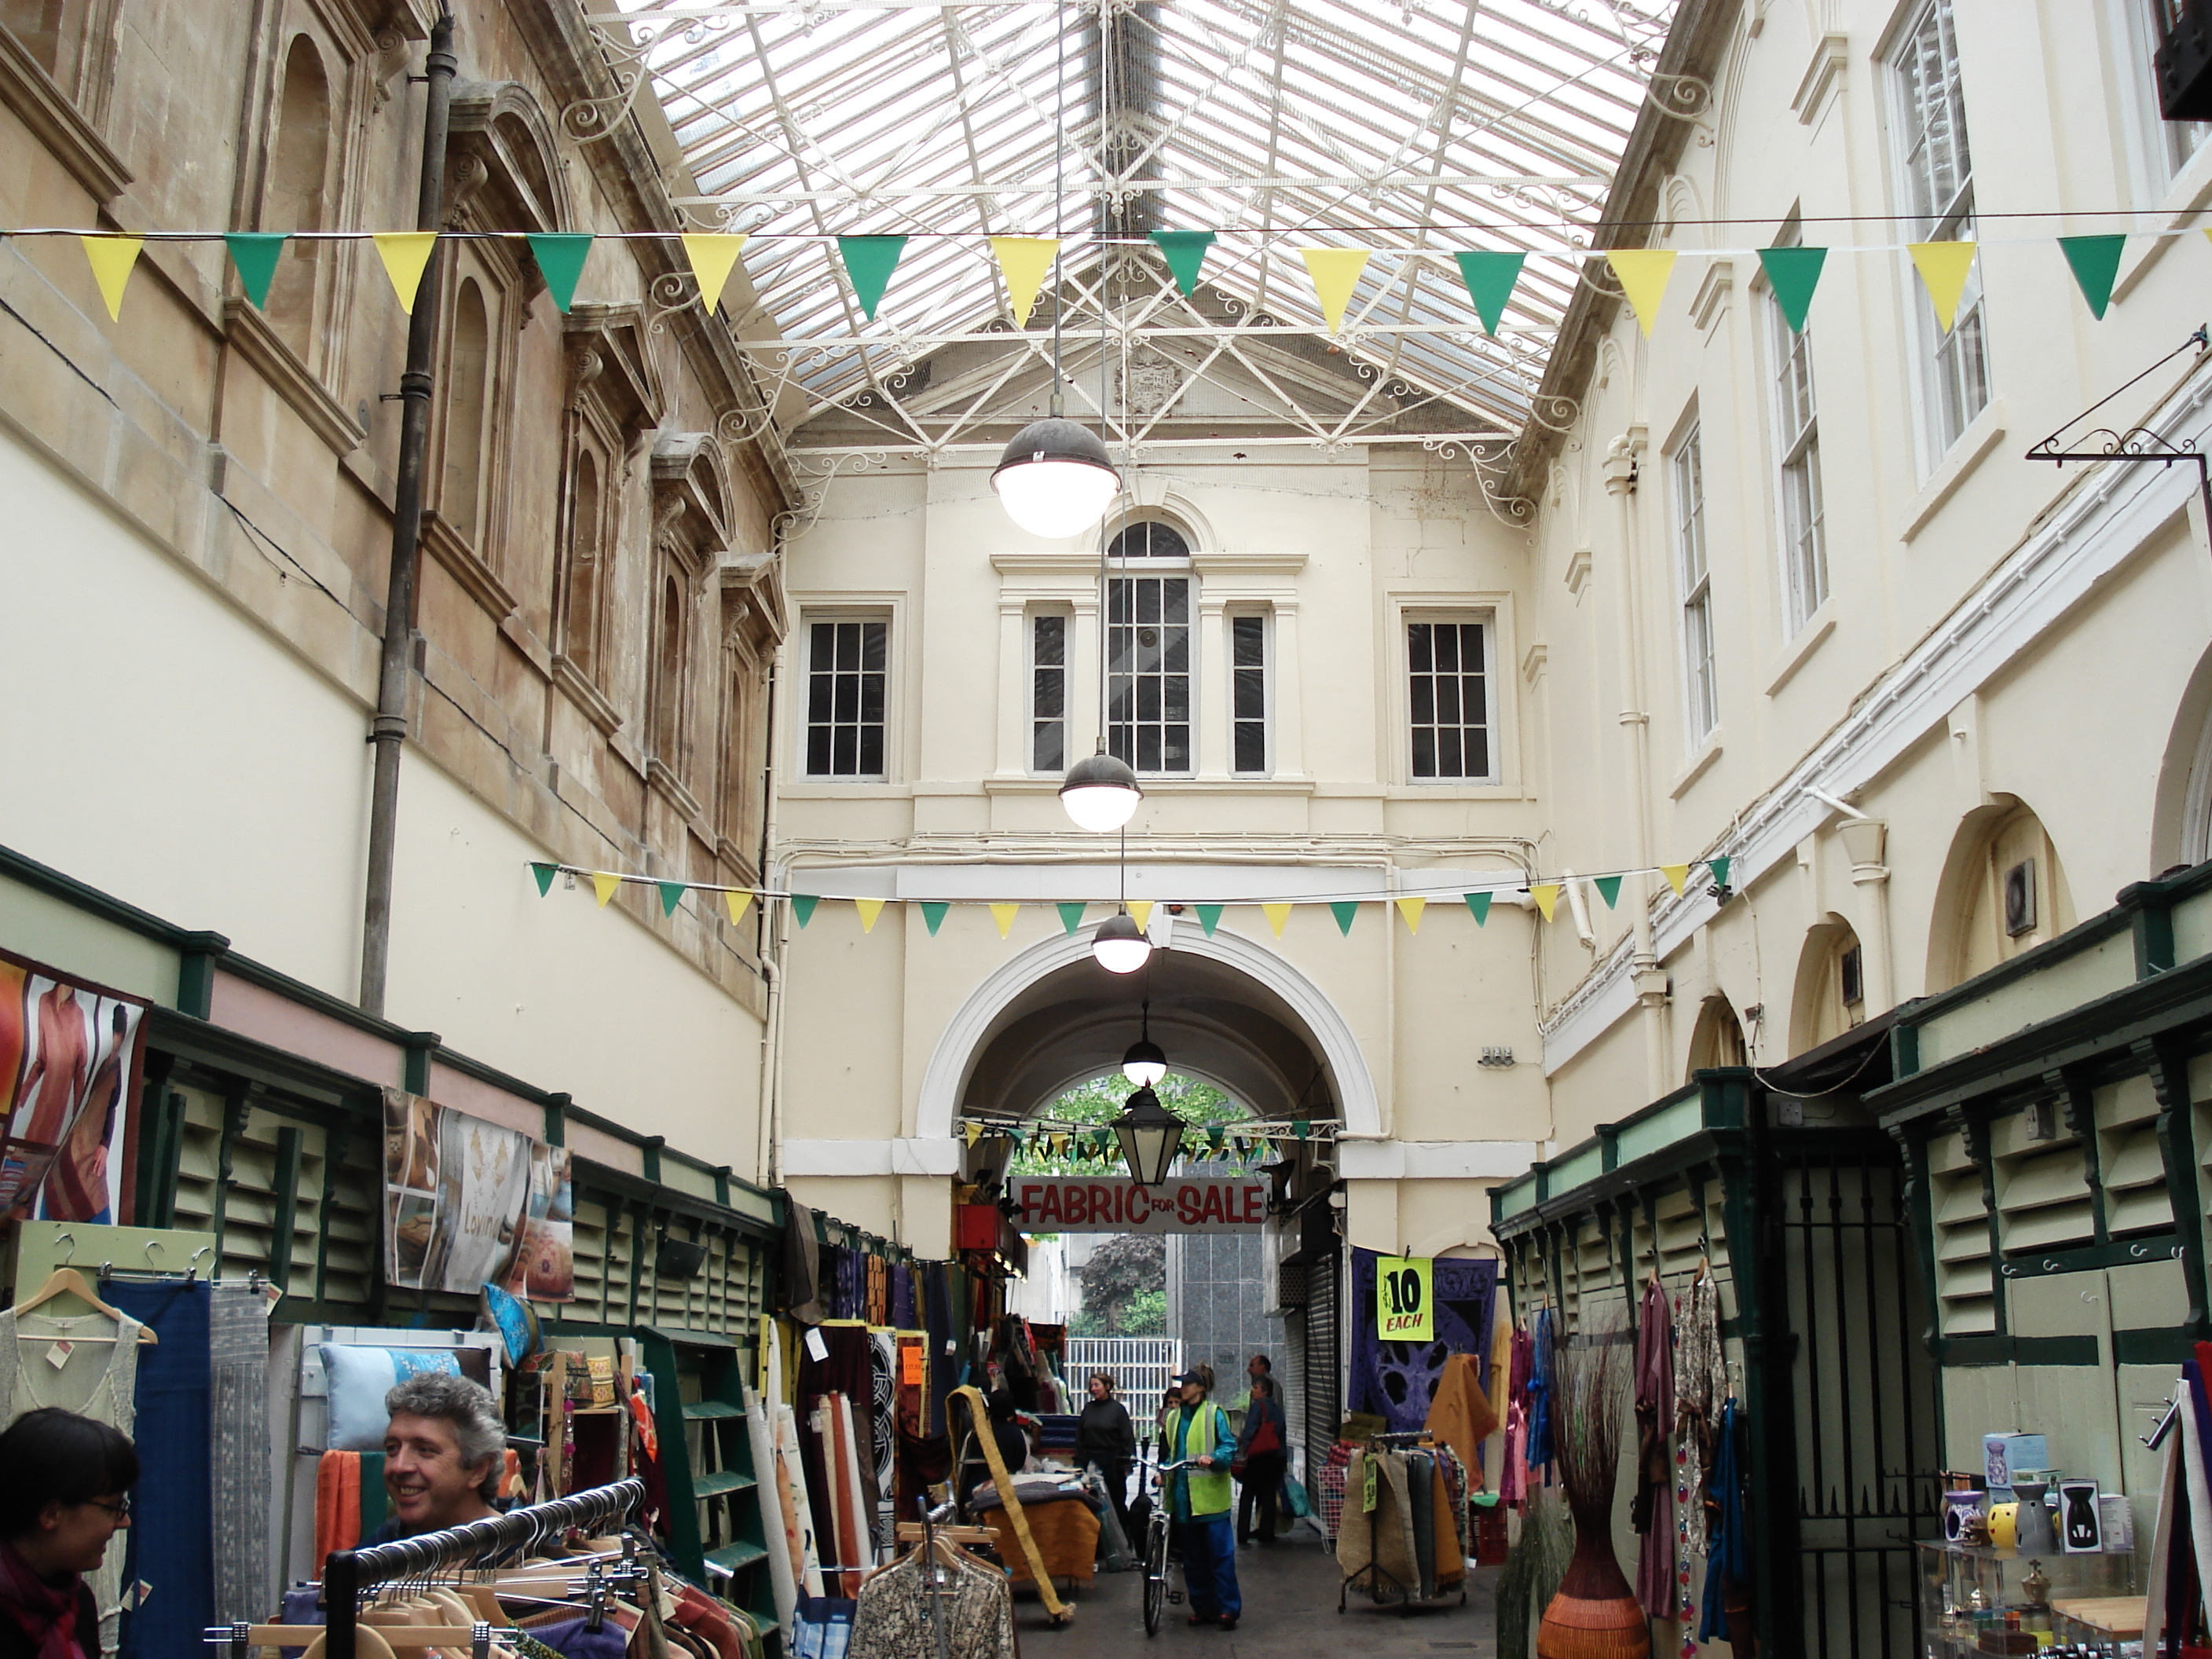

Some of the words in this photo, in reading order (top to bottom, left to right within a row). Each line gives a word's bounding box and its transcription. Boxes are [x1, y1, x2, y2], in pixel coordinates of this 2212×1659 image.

[1022, 1185, 1150, 1225] FABRIC
[1151, 1198, 1175, 1213] FOR
[1177, 1185, 1264, 1225] SALE
[1386, 1268, 1421, 1315] 10
[1386, 1313, 1423, 1332] EACH
